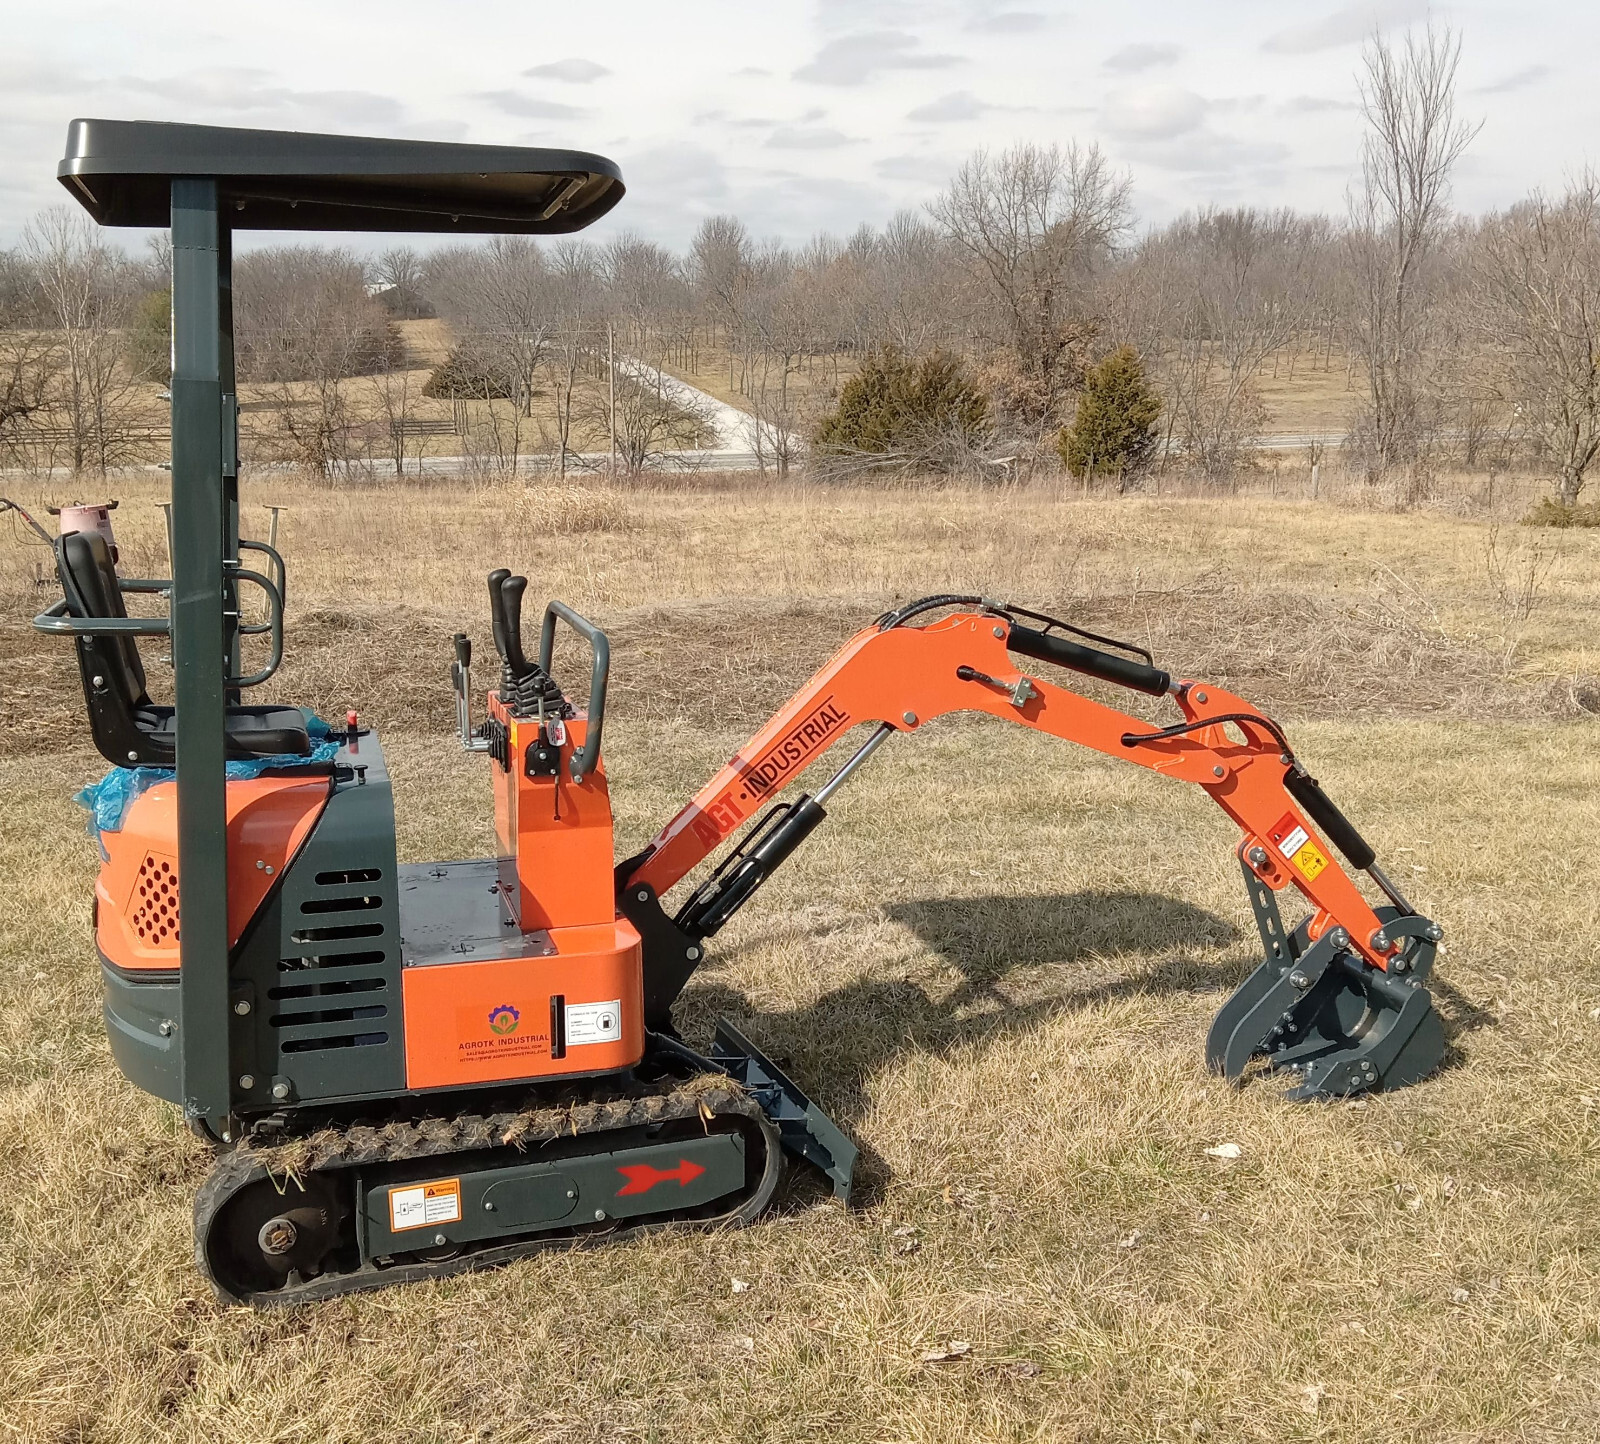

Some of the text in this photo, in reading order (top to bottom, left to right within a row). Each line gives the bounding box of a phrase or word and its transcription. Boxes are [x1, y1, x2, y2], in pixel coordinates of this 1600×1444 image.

[691, 703, 847, 850] AGT INDUSTRIAL
[458, 1034, 550, 1050] AGROTK INDUSTRIAL
